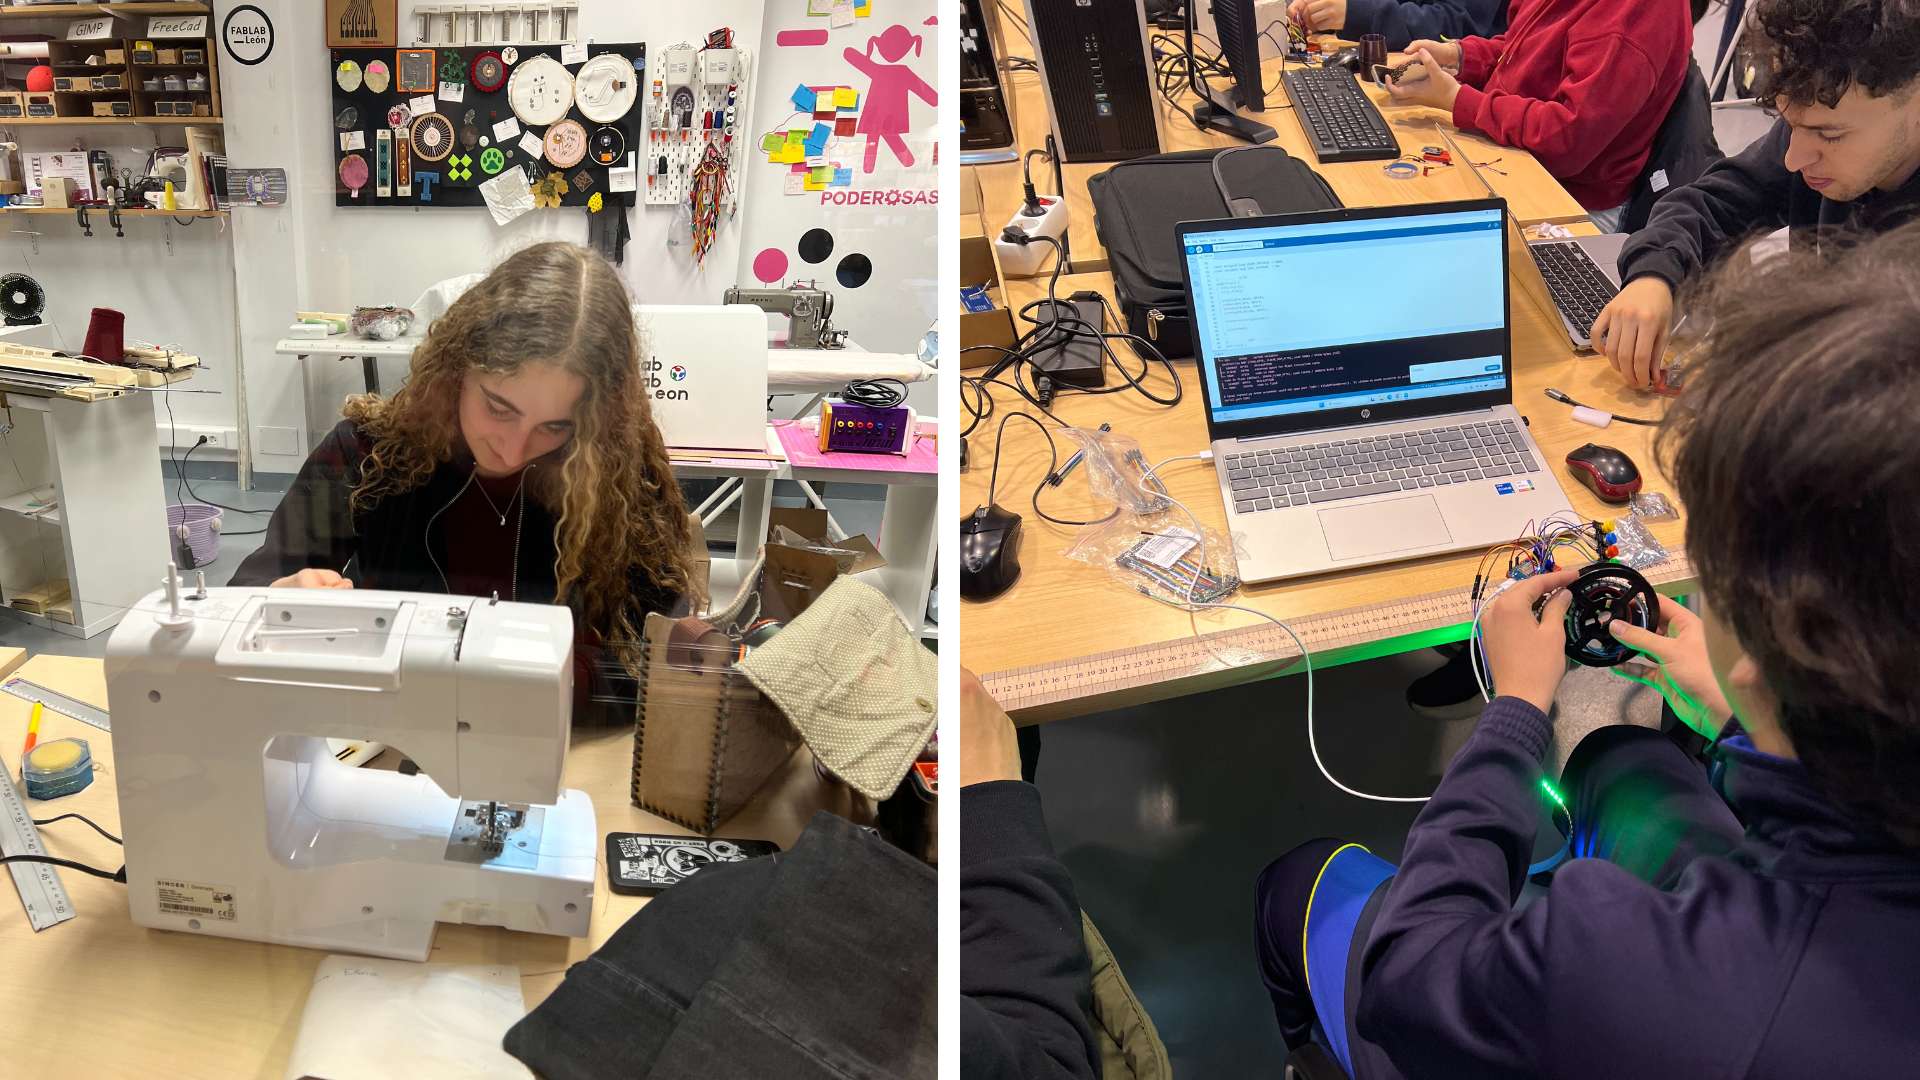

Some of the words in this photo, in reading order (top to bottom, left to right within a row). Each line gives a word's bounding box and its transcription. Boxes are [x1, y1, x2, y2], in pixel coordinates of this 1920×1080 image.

[75, 22, 104, 36] GIMP
[152, 20, 202, 32] FreeCad
[231, 26, 266, 35] FABLAB
[245, 35, 266, 44] León
[821, 190, 938, 206] PODEROSAS
[641, 356, 662, 371] ab
[641, 373, 661, 388] ab
[649, 390, 689, 401] eon
